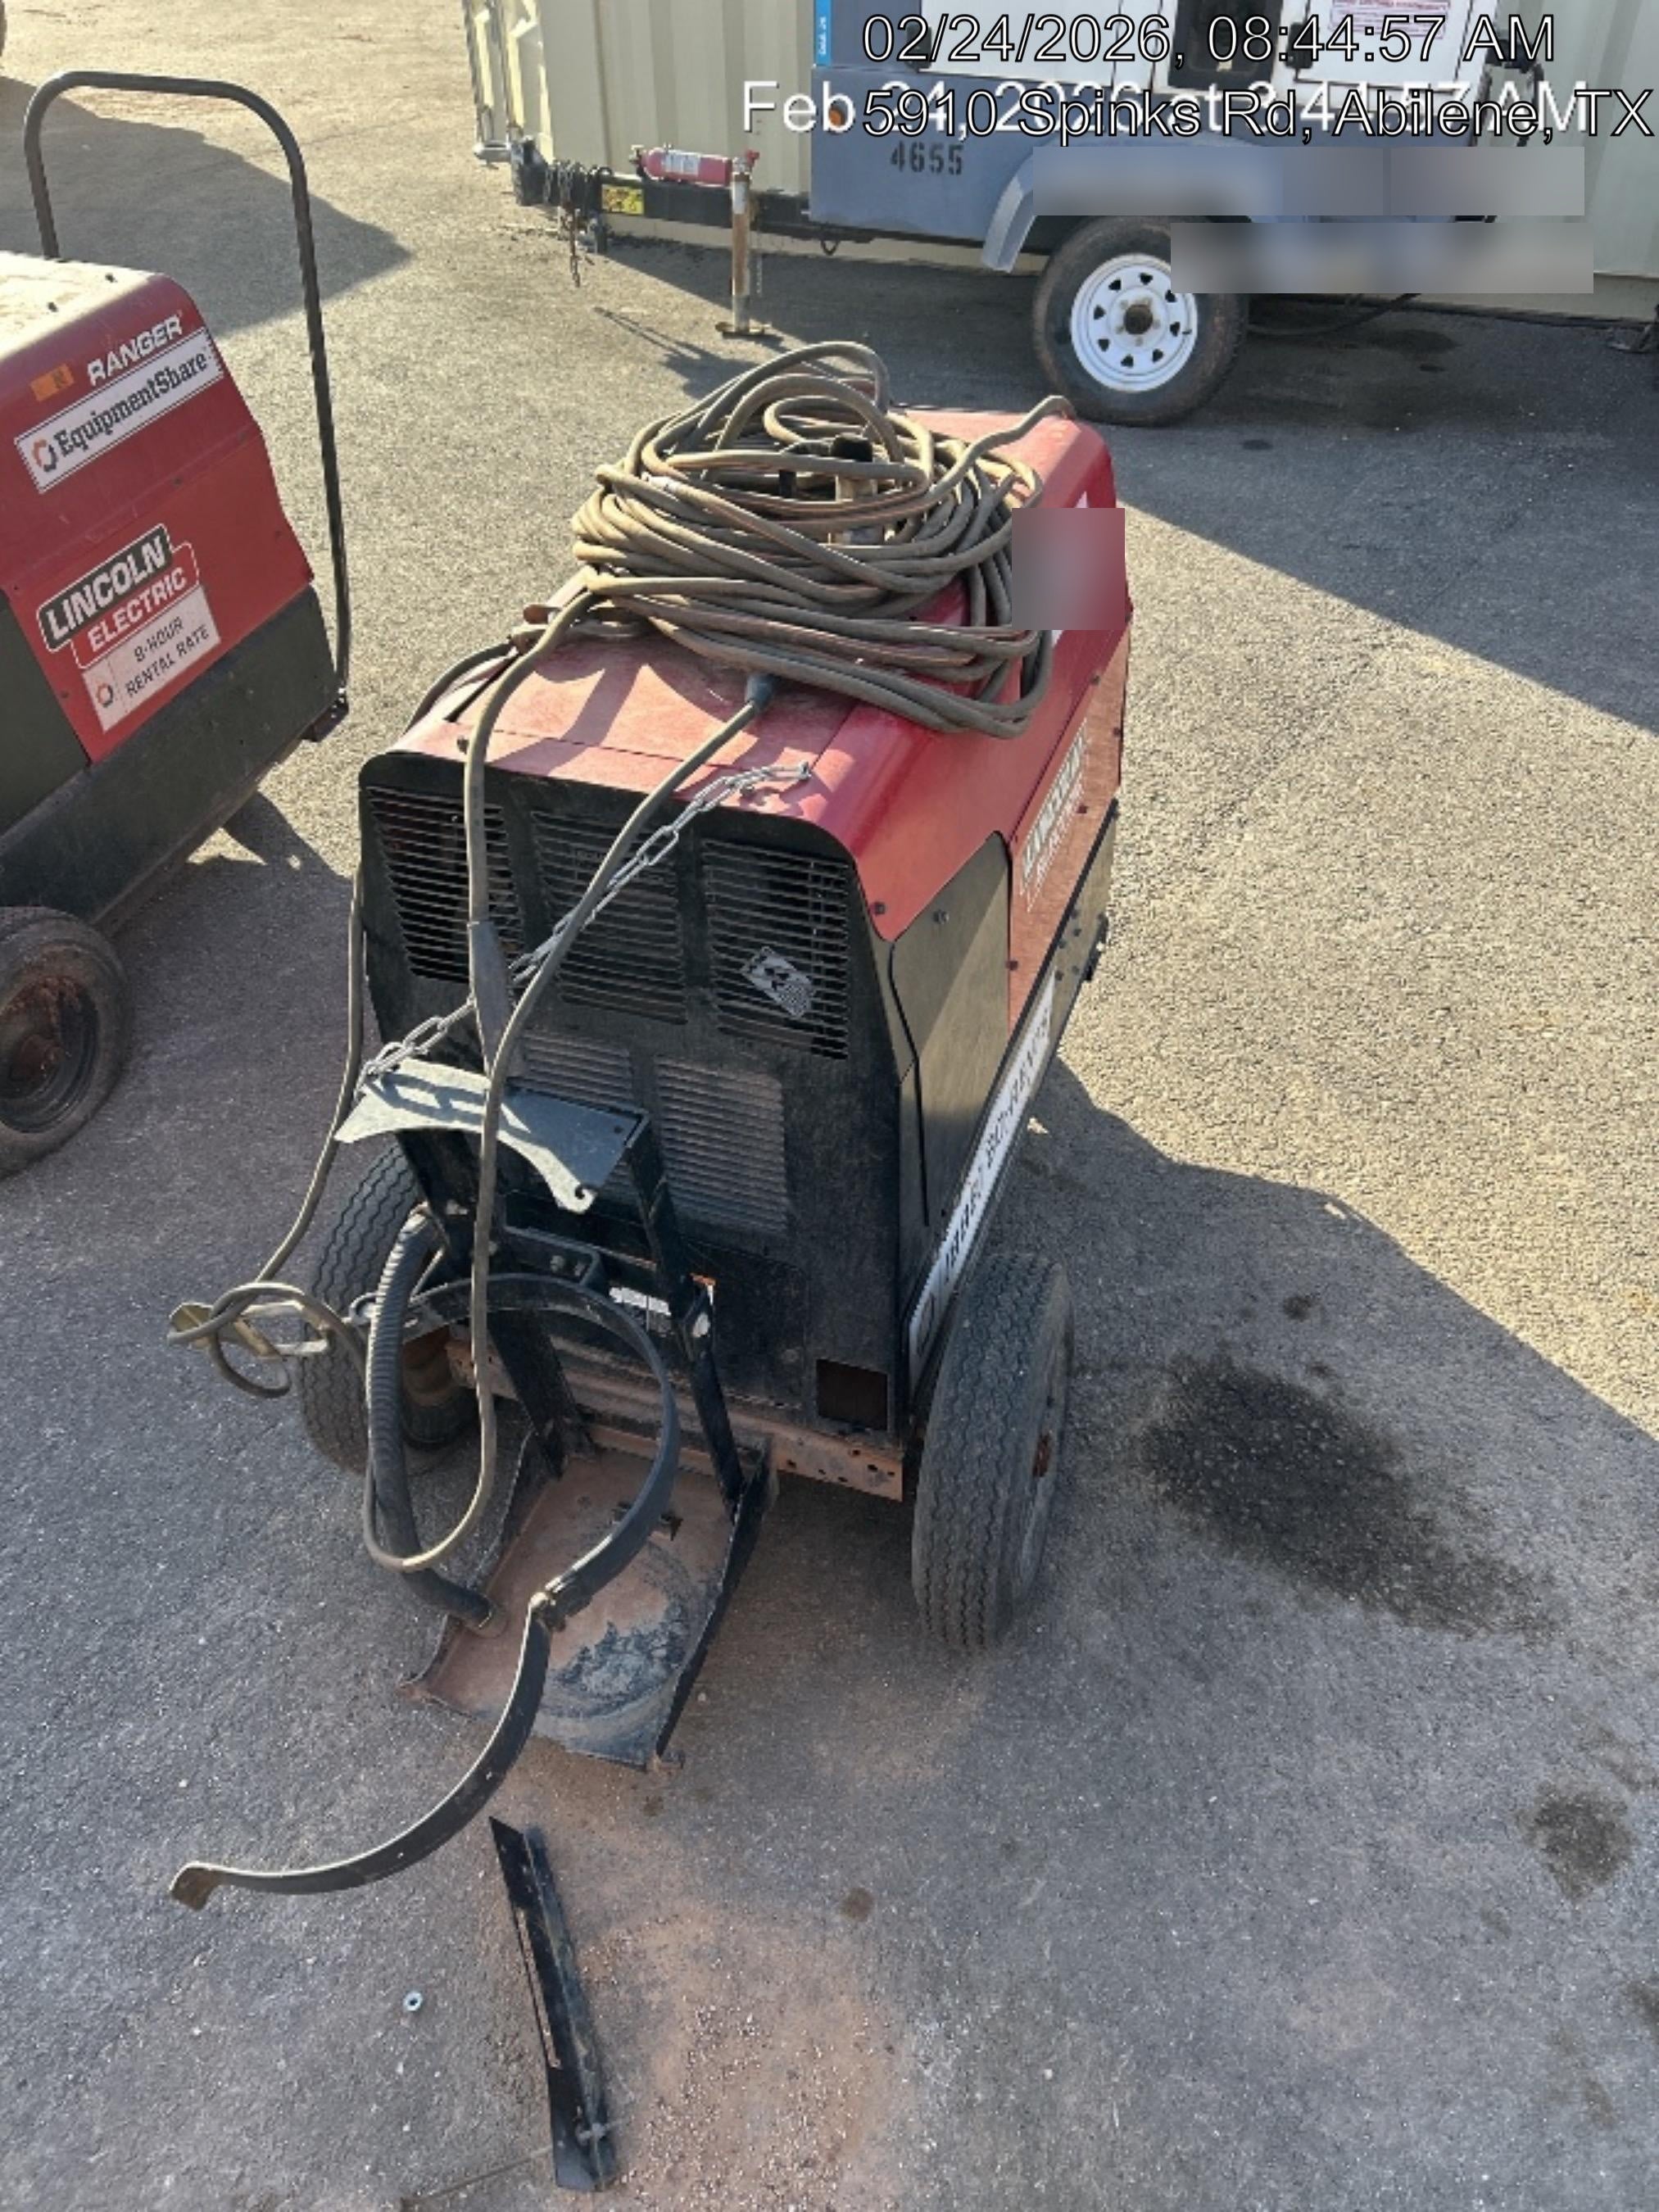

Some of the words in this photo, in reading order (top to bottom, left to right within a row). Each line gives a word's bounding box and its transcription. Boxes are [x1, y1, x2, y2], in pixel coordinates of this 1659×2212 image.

[890, 141, 964, 175] 4655
[87, 315, 183, 387] RANGER
[54, 351, 207, 457] EquipmentShare
[45, 535, 167, 641] LINCOLN
[88, 566, 187, 652] ELECTRIC
[125, 653, 175, 696] RENTAL
[176, 623, 210, 658] RATE
